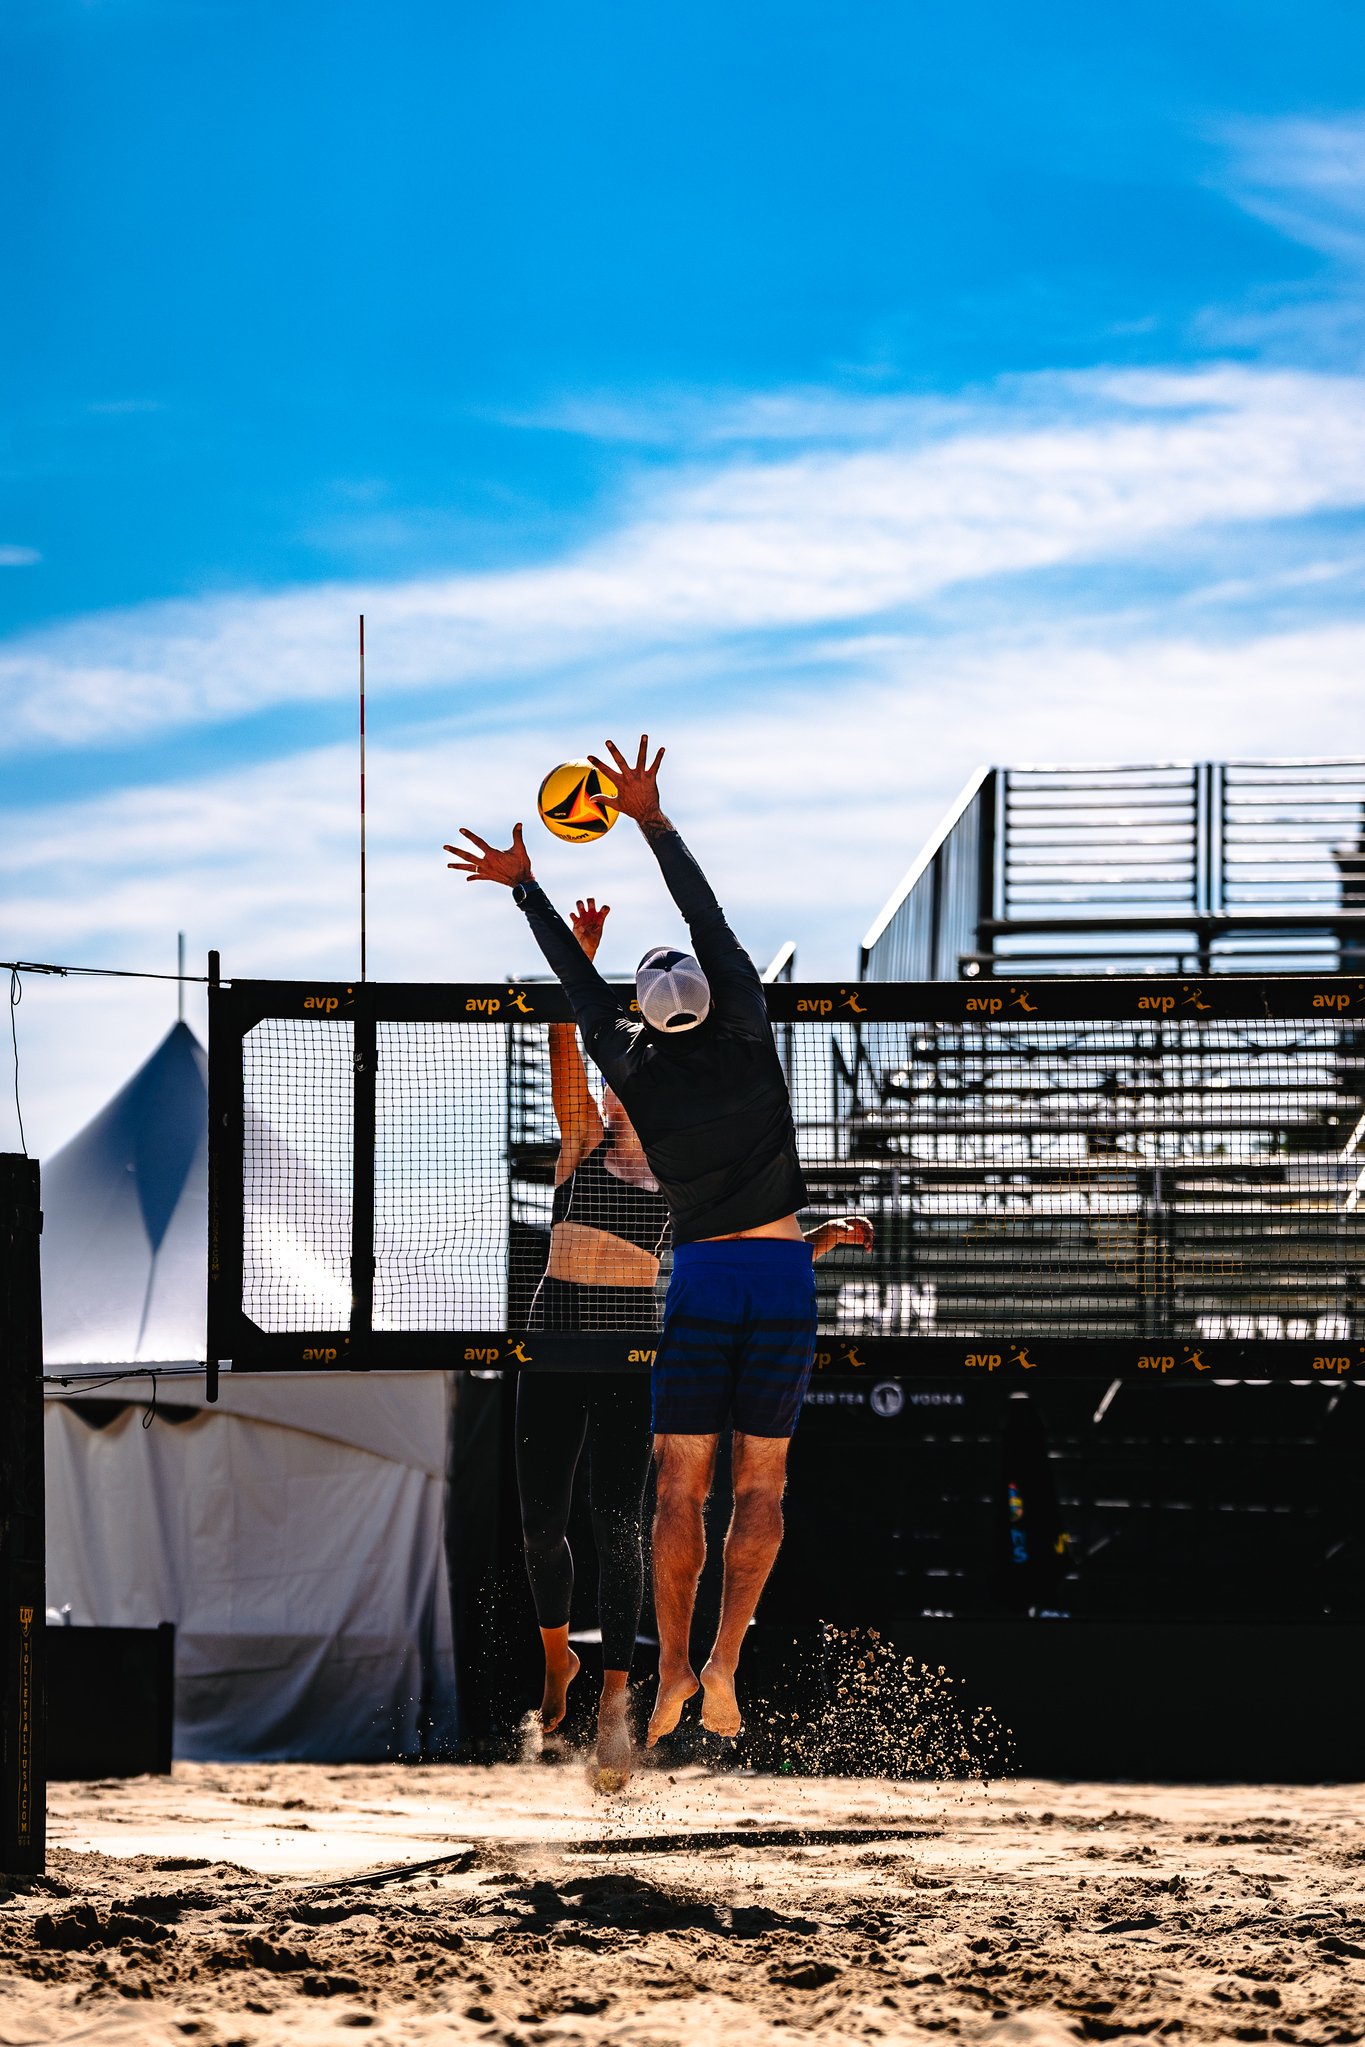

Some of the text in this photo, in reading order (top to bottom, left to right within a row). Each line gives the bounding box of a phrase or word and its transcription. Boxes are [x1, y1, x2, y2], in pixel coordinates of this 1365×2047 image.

[302, 997, 338, 1014] avp
[464, 998, 501, 1016] avp
[795, 999, 832, 1015] avp
[965, 998, 1002, 1015] avp
[1137, 996, 1175, 1013] avp
[1312, 994, 1350, 1011] avp
[302, 1347, 337, 1363] avp
[463, 1348, 499, 1365] avp
[964, 1354, 1001, 1371] avp
[1137, 1355, 1174, 1372] avp
[1312, 1357, 1350, 1374] avp
[838, 1392, 865, 1405] TEA
